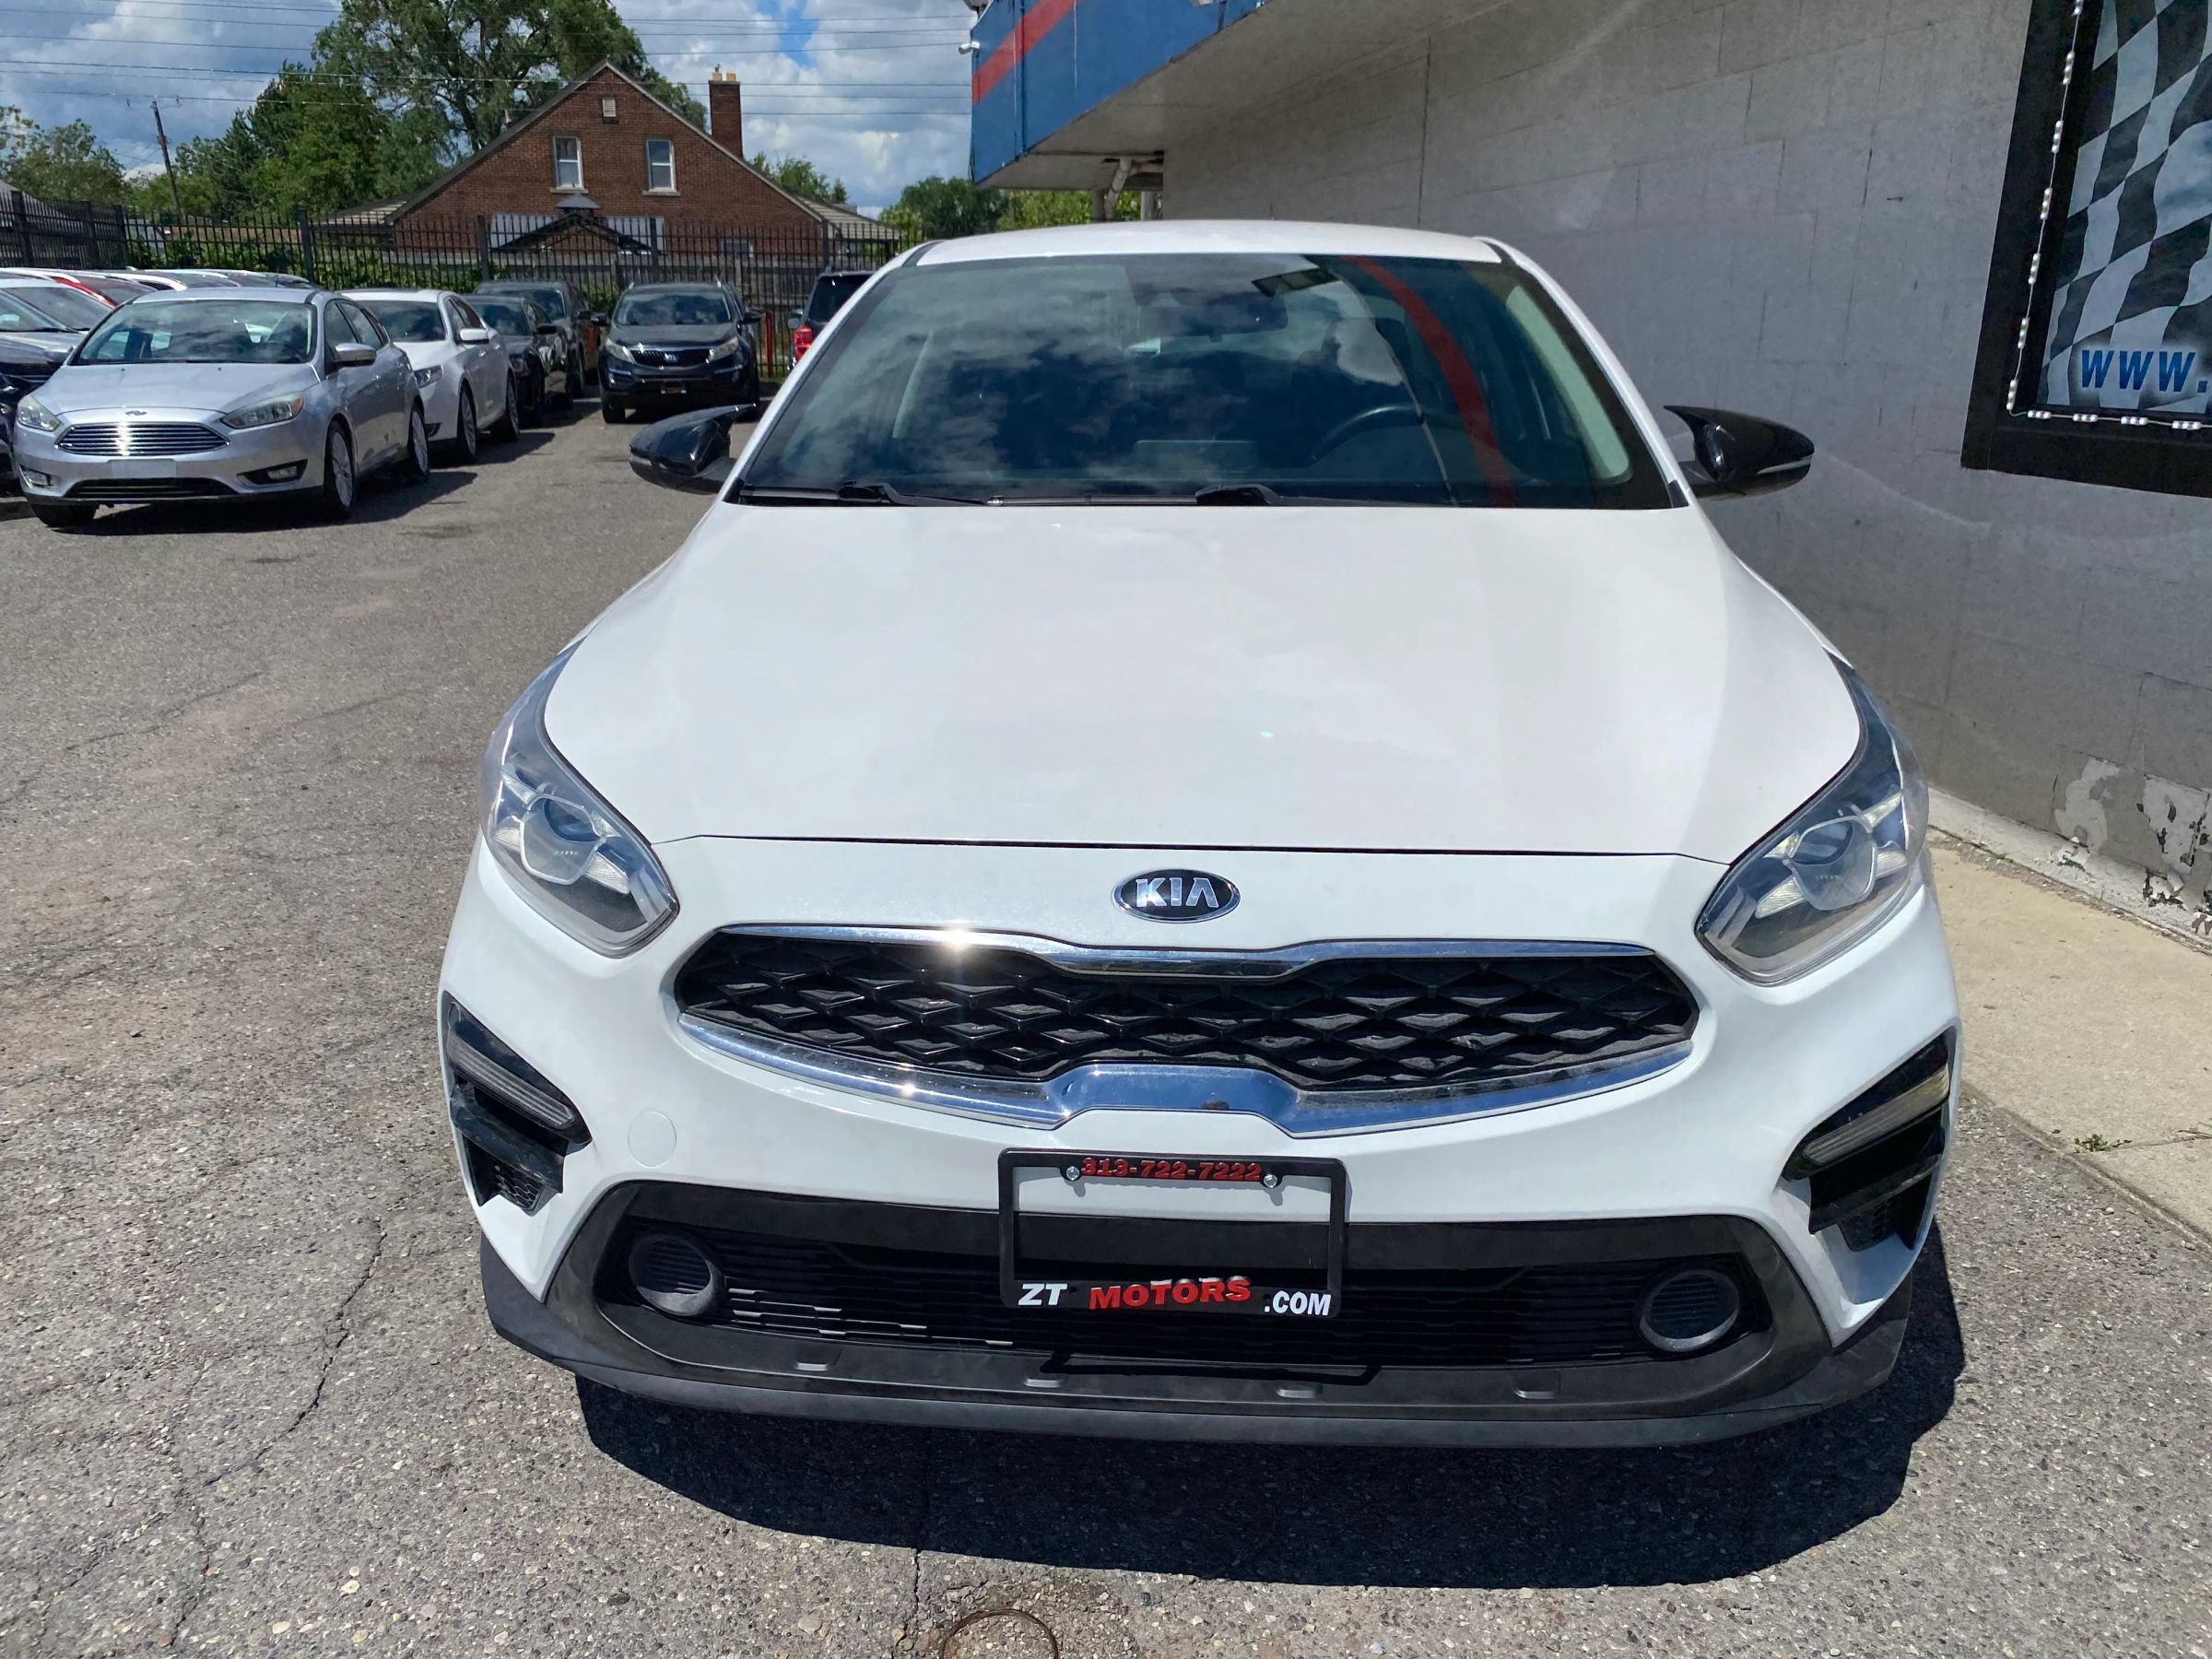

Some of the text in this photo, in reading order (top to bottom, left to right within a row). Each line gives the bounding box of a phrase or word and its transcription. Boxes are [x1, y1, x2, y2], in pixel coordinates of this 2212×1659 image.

[2081, 349, 2208, 394] WWW.
[1135, 877, 1219, 909] KIA
[1081, 1157, 1263, 1181] 313-722-7222
[1018, 1276, 1333, 1316] ZT MOTORS .COM
